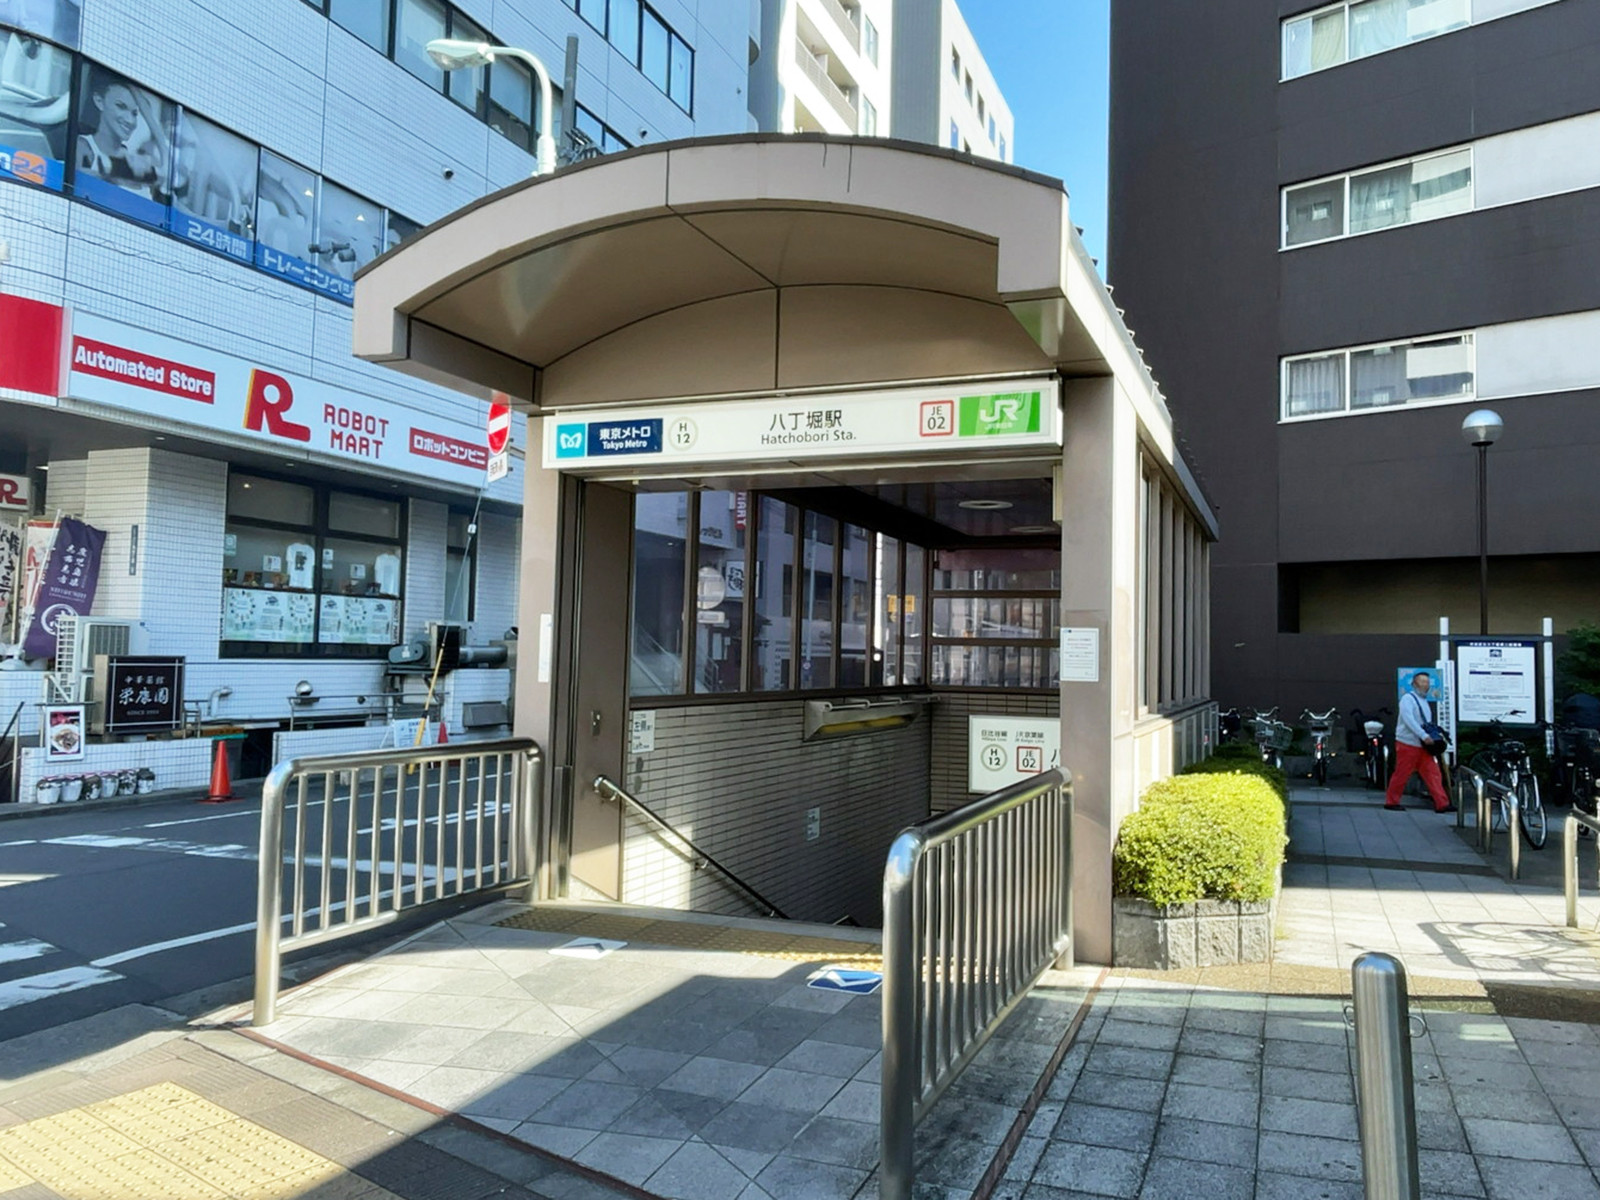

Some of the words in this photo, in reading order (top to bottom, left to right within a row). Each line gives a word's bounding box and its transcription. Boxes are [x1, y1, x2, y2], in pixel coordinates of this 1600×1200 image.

[75, 345, 164, 384] Automated
[169, 369, 212, 396] Store
[243, 368, 311, 442] R
[931, 405, 943, 416] JE
[979, 399, 1019, 422] JR
[323, 403, 390, 438] ROBOT
[679, 422, 687, 432] H
[769, 409, 842, 431] 八丁堀駅
[927, 416, 946, 430] 02
[599, 425, 651, 440] 東京メトロ
[676, 433, 691, 444] 12
[761, 430, 829, 445] Hatchobori
[833, 429, 857, 441] Sta.
[330, 428, 383, 459] MART
[413, 434, 486, 465] ロボットコンビニ
[602, 440, 624, 451] Tokyo
[625, 439, 648, 450] Metro
[990, 748, 998, 756] H
[1025, 750, 1033, 758] JE
[988, 756, 1001, 766] 12
[1022, 758, 1036, 768] 02
